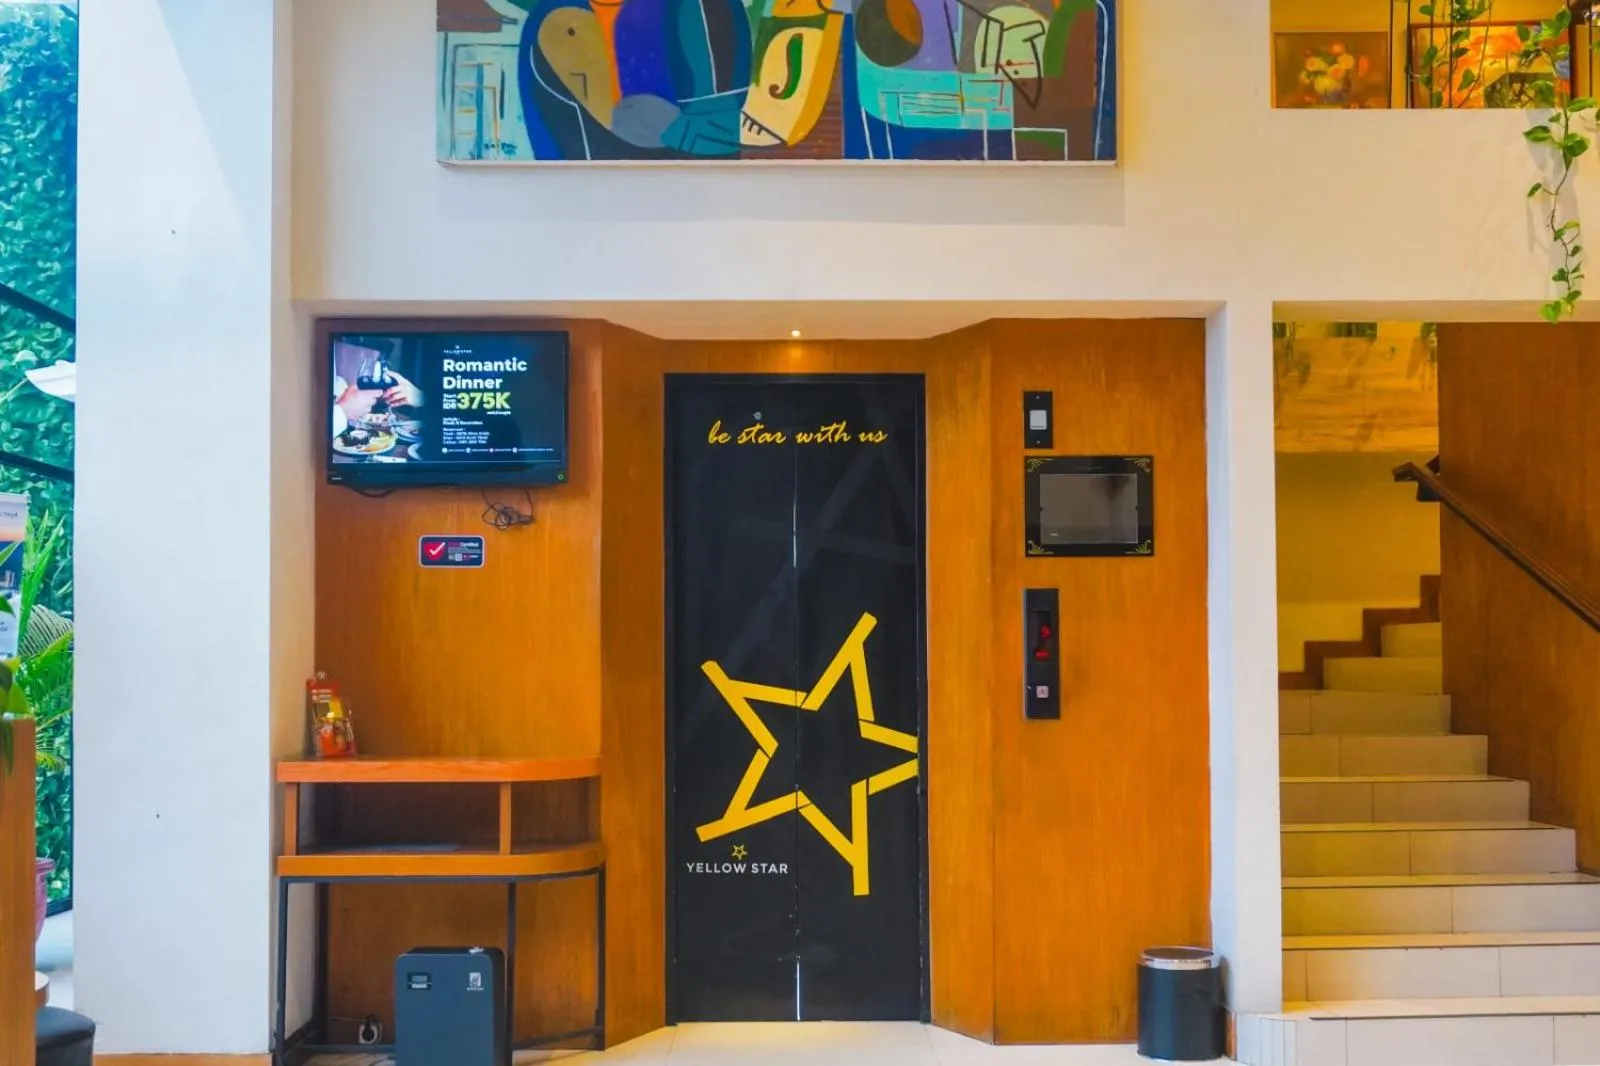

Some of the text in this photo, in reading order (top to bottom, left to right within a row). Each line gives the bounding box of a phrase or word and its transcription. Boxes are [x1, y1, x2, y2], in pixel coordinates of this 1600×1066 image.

[443, 357, 528, 372] Romantic
[443, 375, 503, 389] Dinner
[457, 392, 511, 410] 375K
[708, 419, 888, 444] be star with us
[686, 862, 788, 874] YELLOW STAR
